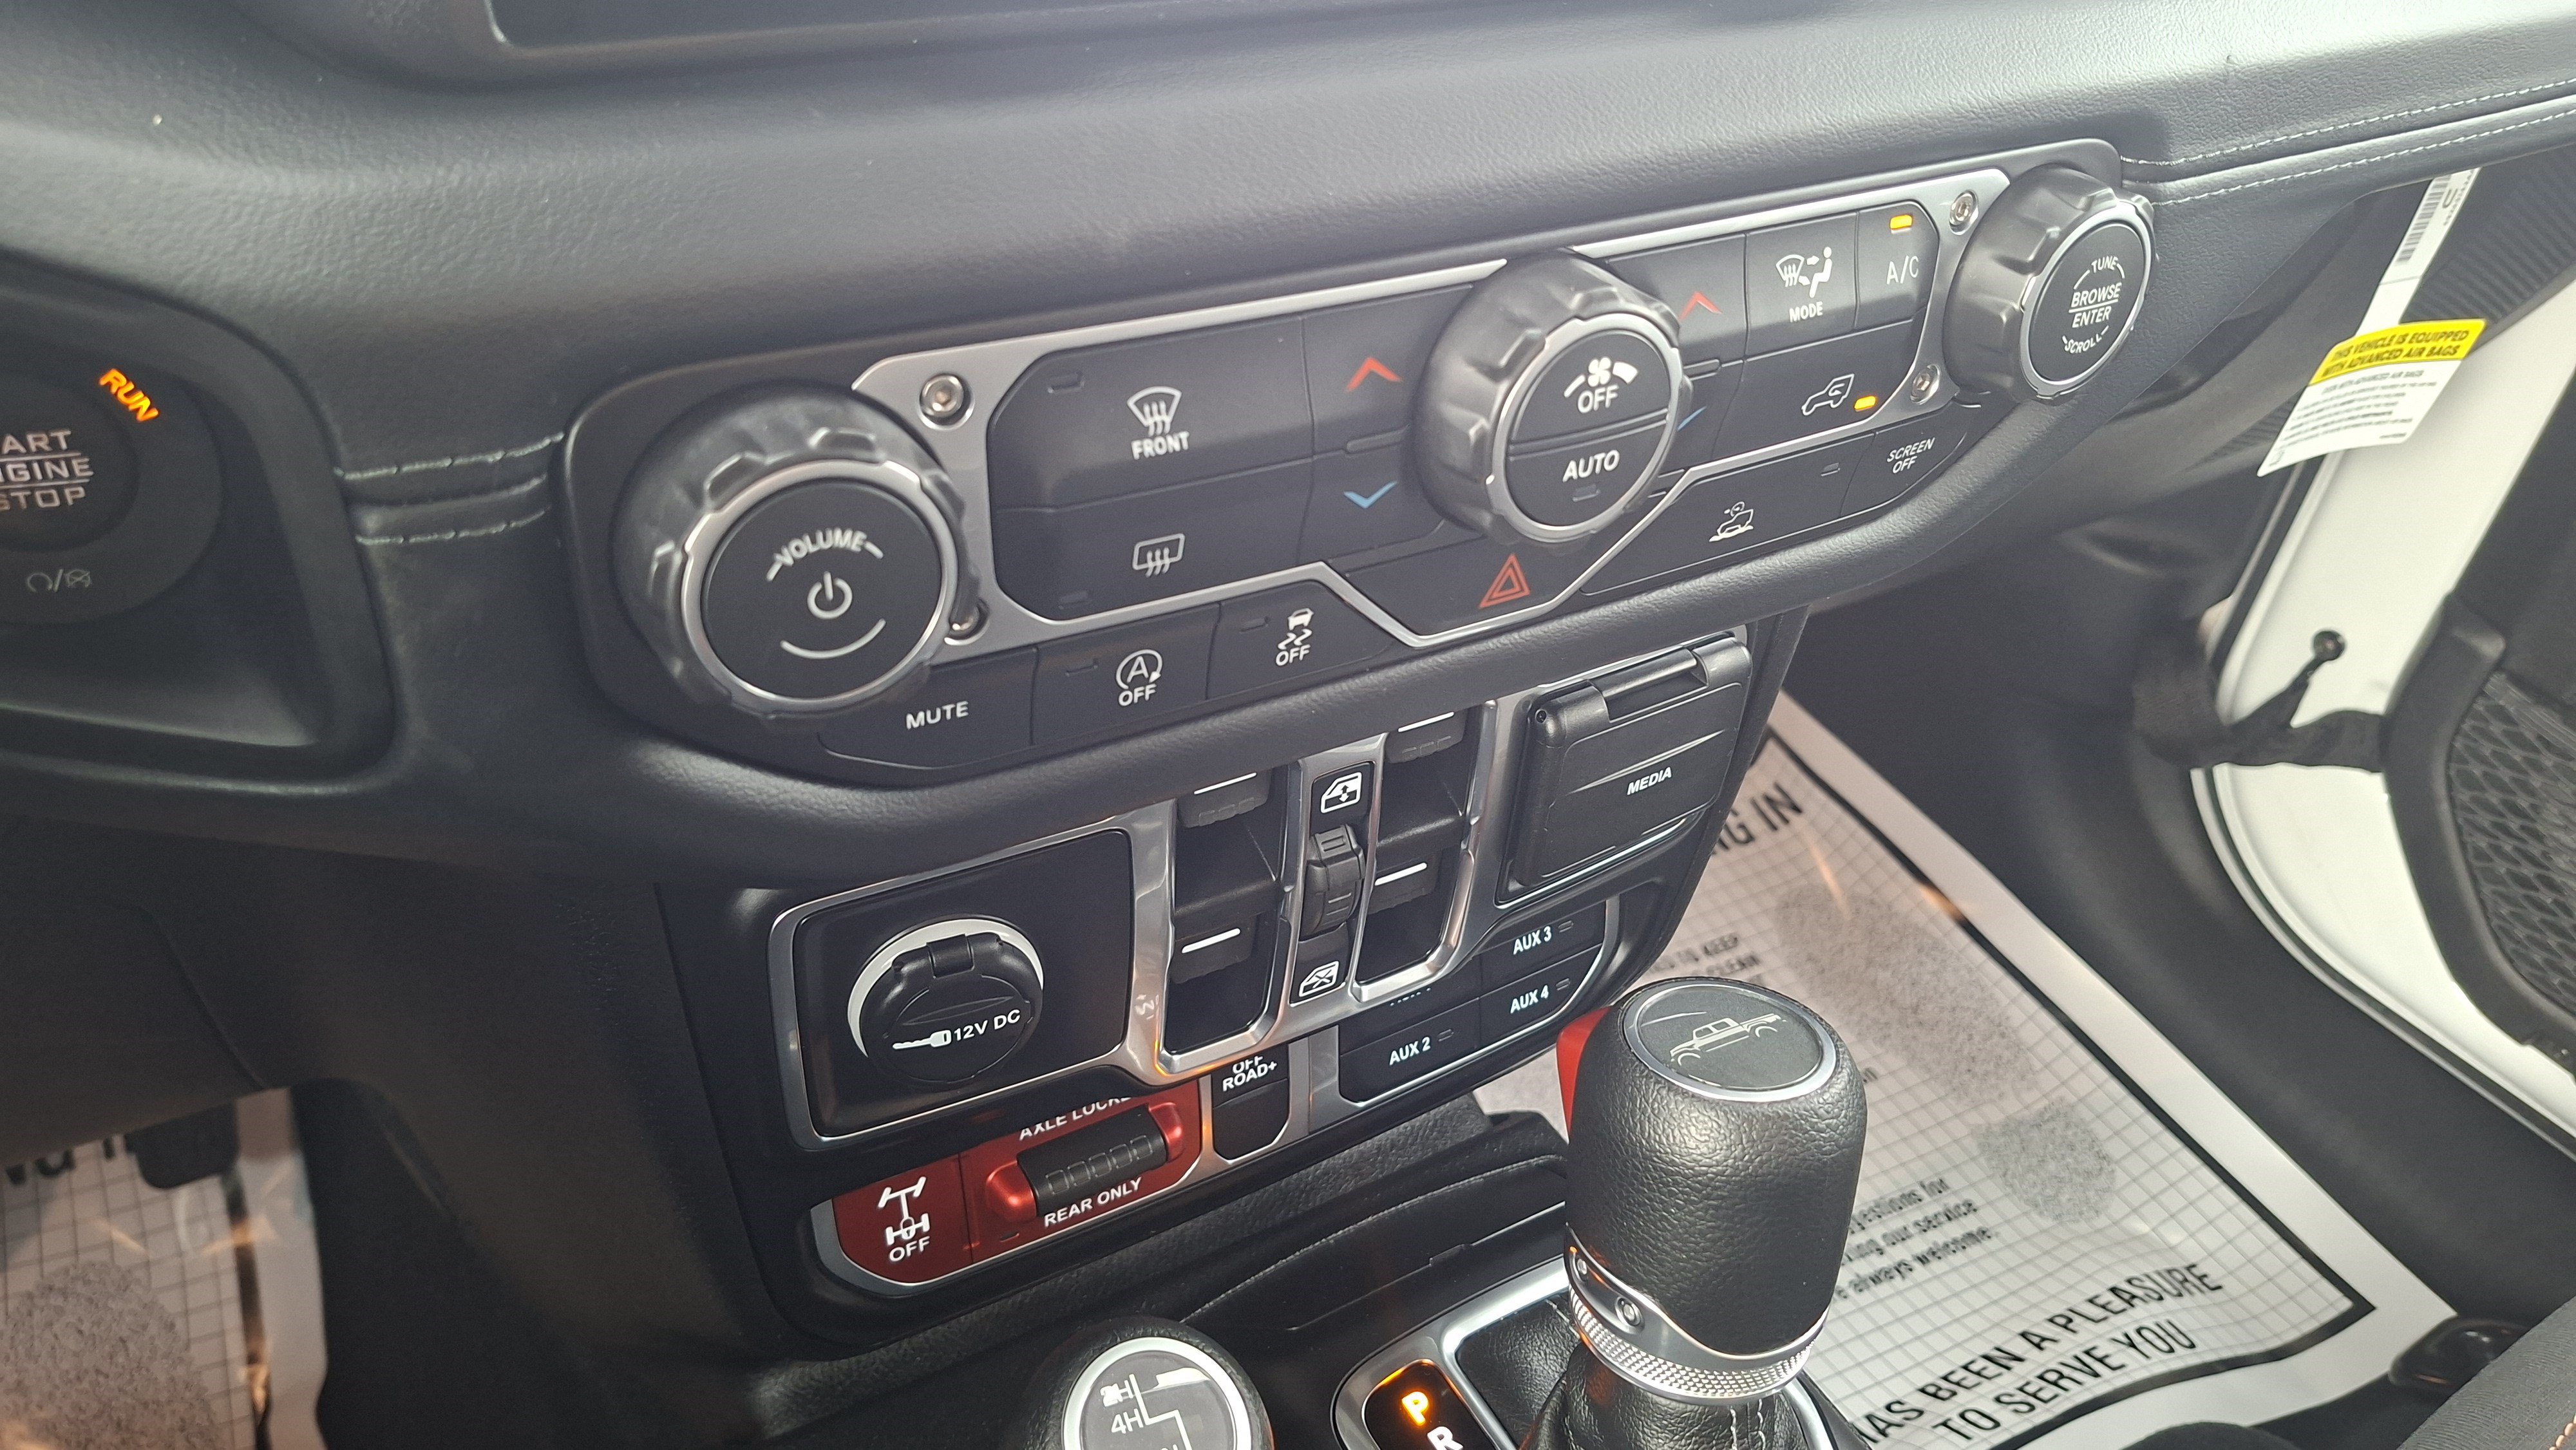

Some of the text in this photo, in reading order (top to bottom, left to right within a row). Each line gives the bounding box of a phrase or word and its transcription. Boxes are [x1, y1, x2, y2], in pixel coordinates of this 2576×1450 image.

[1886, 255, 1919, 284] A/C
[2091, 256, 2118, 273] TUNE
[2070, 282, 2122, 308] BROWSE
[1788, 301, 1824, 323] MODE
[2072, 306, 2112, 328] ENTER
[2064, 334, 2102, 353] SCROLL
[2353, 334, 2395, 353] VEHICLE
[2395, 332, 2407, 345] IS
[2408, 330, 2470, 344] EQUIPPED
[2346, 348, 2403, 369] ADVANCED
[2403, 346, 2427, 359] AIR
[2426, 344, 2461, 357] BAGS
[99, 368, 160, 422] RUN
[1577, 384, 1620, 413] OFF
[1, 429, 71, 454] ART
[1131, 431, 1190, 460] FRONT
[1887, 437, 1935, 462] SCREEN
[0, 458, 94, 483] GINE
[1562, 449, 1620, 482] AUTO
[1892, 455, 1918, 474] OFF
[775, 528, 867, 567] VOLUME
[1275, 644, 1311, 666] OFF
[1119, 684, 1157, 706] OFF
[906, 701, 969, 730] MUTE
[1627, 766, 1672, 795] MEDIA
[1750, 781, 1803, 831] IN
[1513, 926, 1552, 955] AUX 3
[1510, 984, 1549, 1014] AUX 4
[954, 1009, 1021, 1041] 12V DC
[1389, 1036, 1431, 1066] AUX 2
[1222, 1061, 1278, 1091] ROAD+
[1019, 1115, 1068, 1141] AXLE
[1044, 1176, 1142, 1228] REAR ONLY
[887, 1237, 931, 1263] OFF
[1917, 1346, 2025, 1402] BEEN
[2018, 1329, 2060, 1352] A
[2047, 1263, 2224, 1335] PLEASURE
[1931, 1319, 2197, 1441] TO SERVE YOU
[1111, 1408, 1144, 1434] 4H
[1401, 1391, 1429, 1427] P
[1426, 1426, 1464, 1450] R
